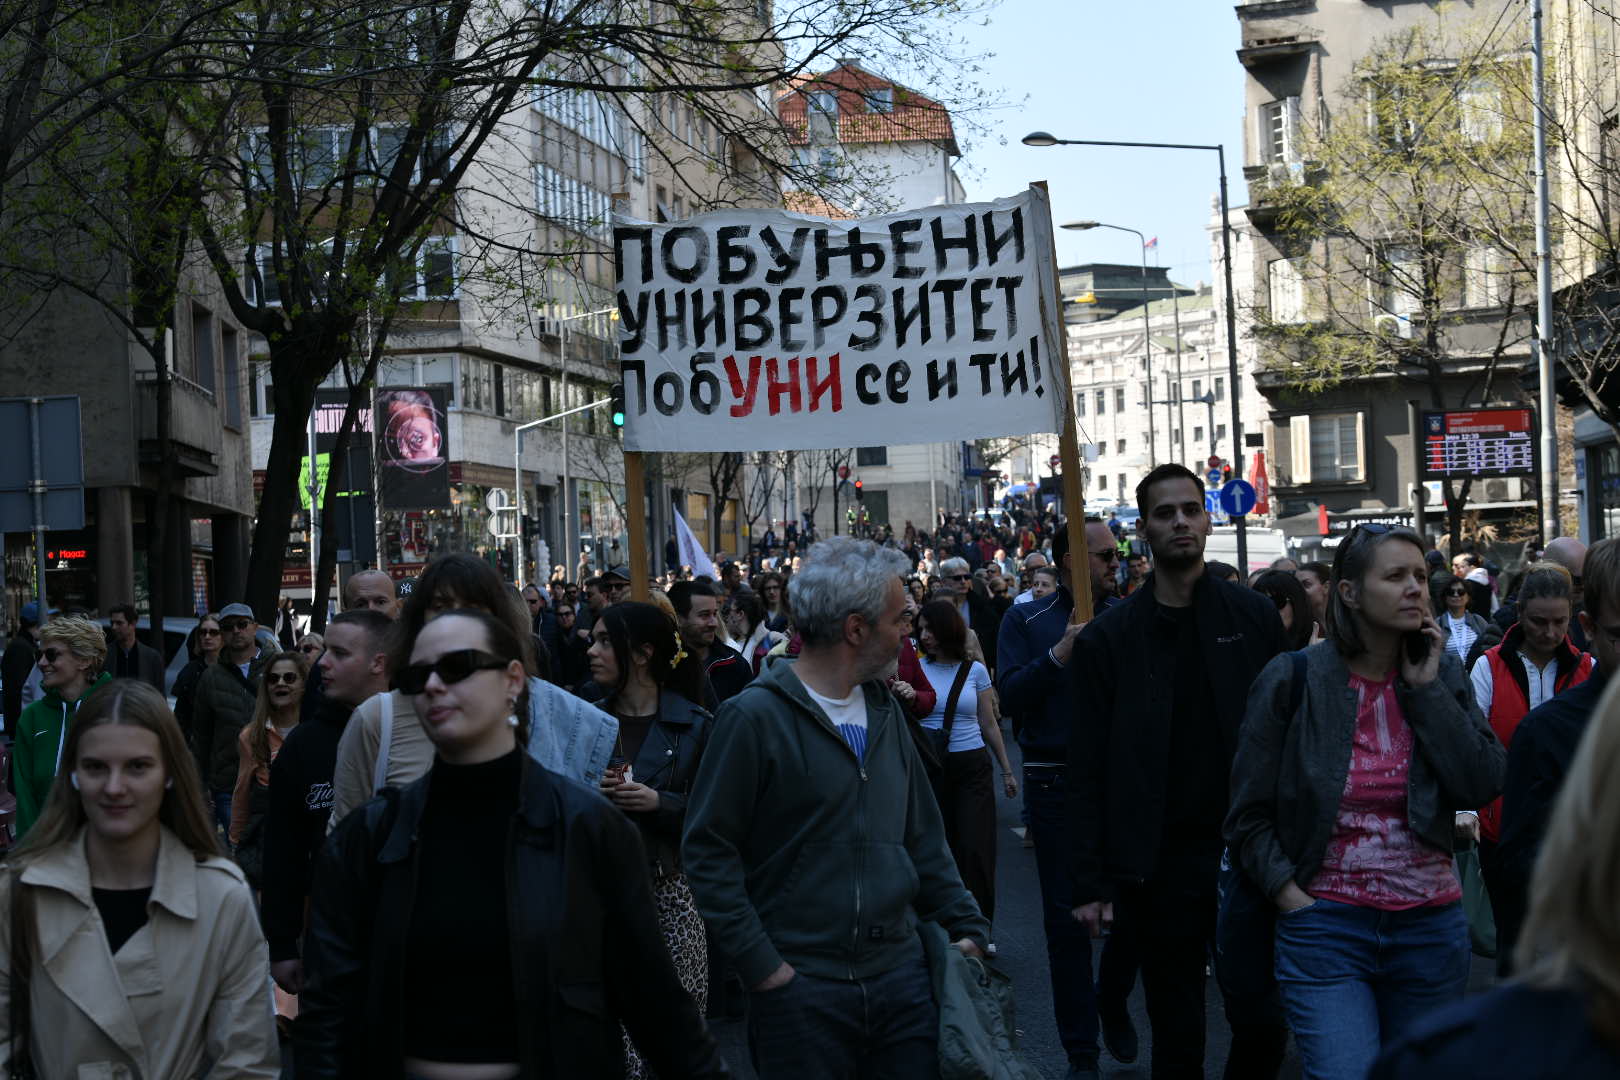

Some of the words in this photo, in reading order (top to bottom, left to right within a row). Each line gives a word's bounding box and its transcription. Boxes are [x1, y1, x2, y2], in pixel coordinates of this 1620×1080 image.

[613, 207, 1026, 285] ПОБУЊЕНИ
[616, 276, 1023, 354] УНИВЕРЗИТЕТ
[620, 352, 843, 418] ПобУНИ
[855, 359, 911, 406] се
[926, 358, 960, 402] и
[969, 335, 1045, 400] ти!
